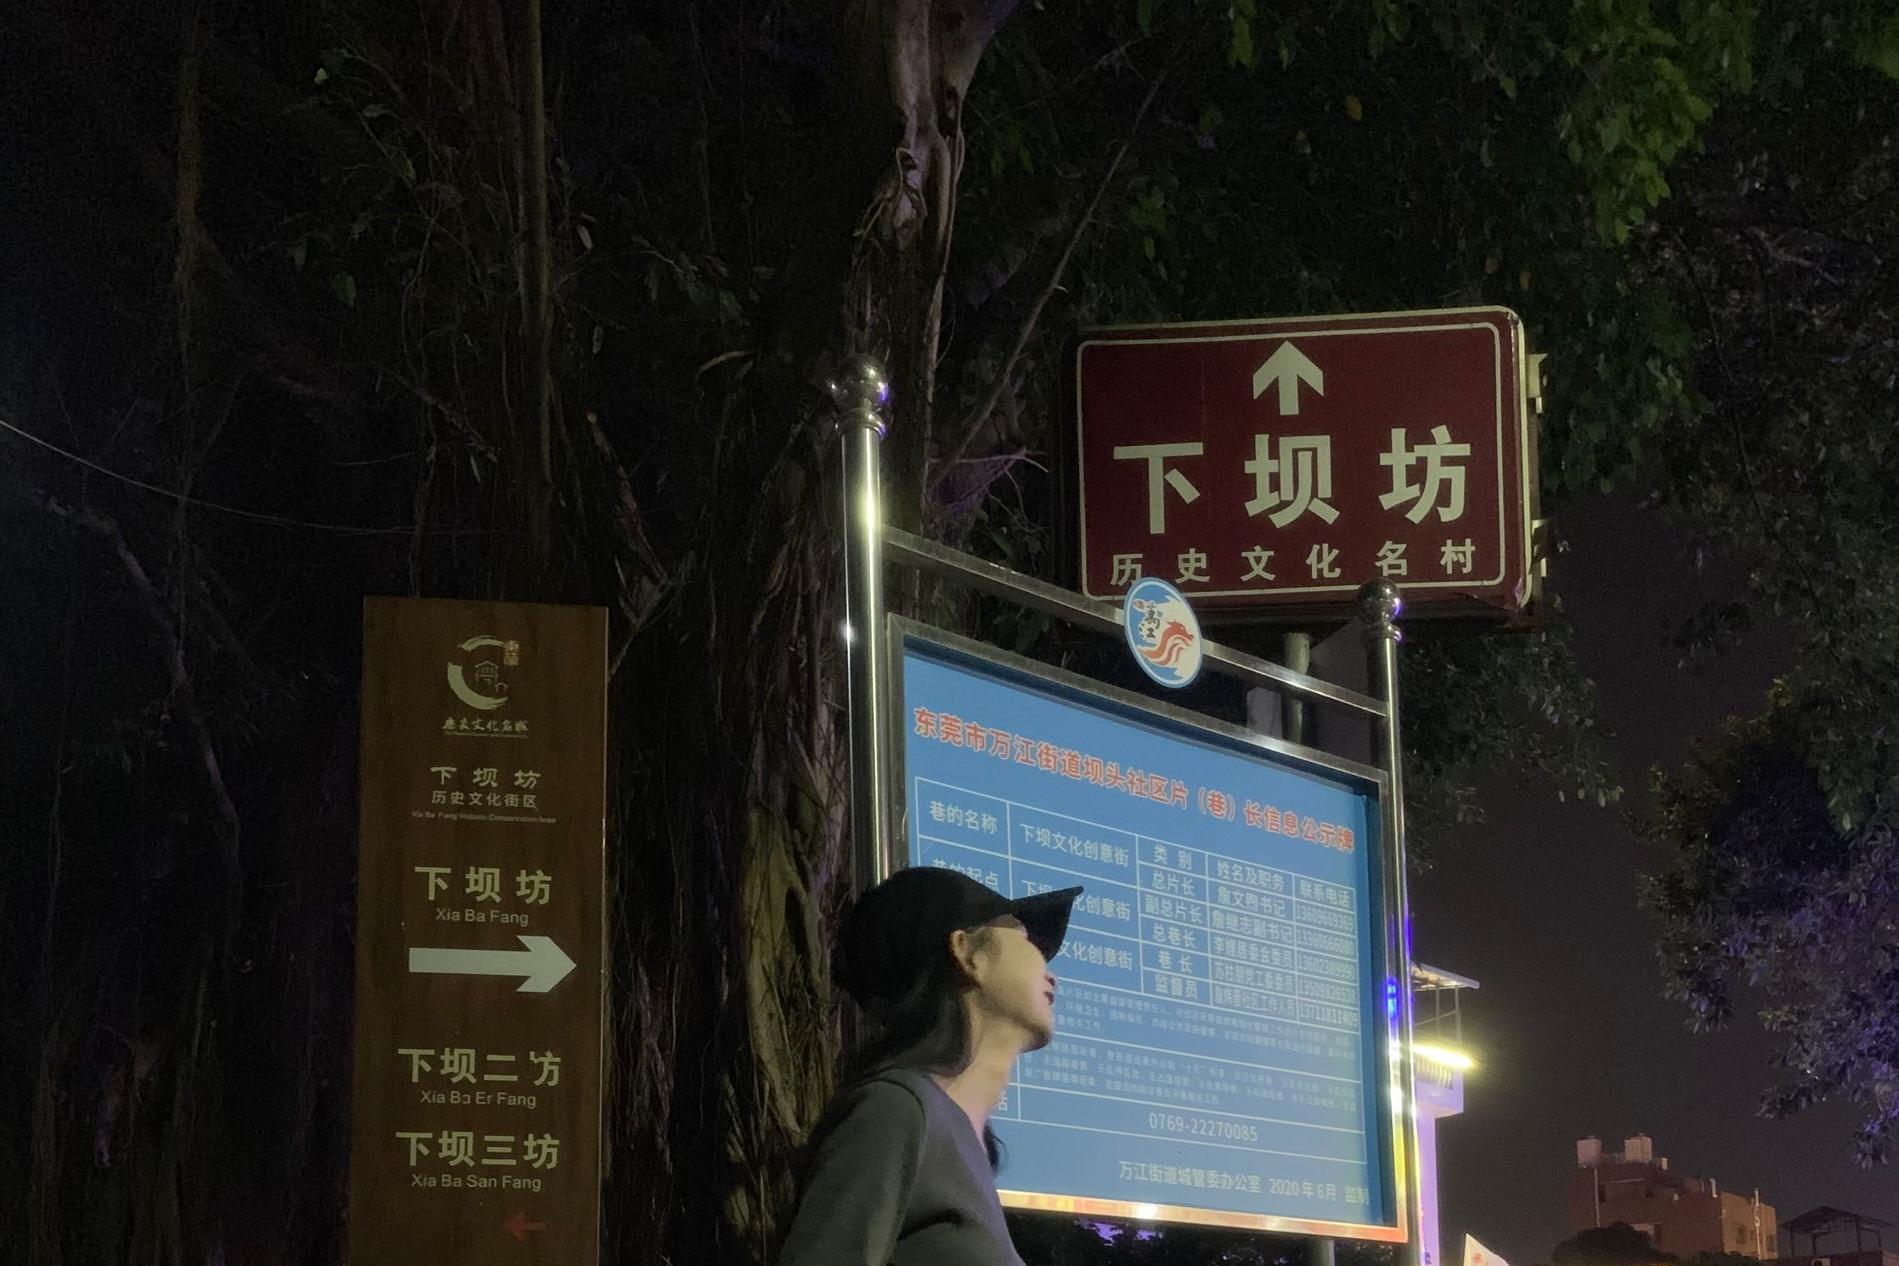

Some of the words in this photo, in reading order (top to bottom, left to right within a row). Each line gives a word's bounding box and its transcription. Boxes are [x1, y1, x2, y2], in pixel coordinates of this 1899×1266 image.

[1112, 424, 1472, 535] 下坝坊
[1110, 538, 1476, 586] 历史文化名村
[430, 766, 541, 789] 下坝坊
[431, 790, 538, 809] 历史文化街区
[929, 800, 998, 835] 巷的名称
[1020, 823, 1129, 867] 下坝文化创意街
[414, 866, 553, 905] 下坝坊
[1151, 870, 1195, 897] 总片长
[435, 908, 460, 922] Xia
[464, 909, 486, 922] Ba
[490, 911, 529, 927] Fang
[1144, 895, 1202, 923] 副总片长
[1154, 973, 1198, 999] 监督员
[420, 1090, 446, 1104] Xia
[475, 1092, 493, 1105] Er
[497, 1092, 537, 1110] Fang
[1148, 1112, 1258, 1142] 0769-22270085
[396, 1131, 560, 1169] 下坝三坊
[411, 1174, 437, 1188] Xia
[441, 1174, 462, 1188] Ba
[466, 1175, 498, 1189] San
[502, 1175, 542, 1192] Fang
